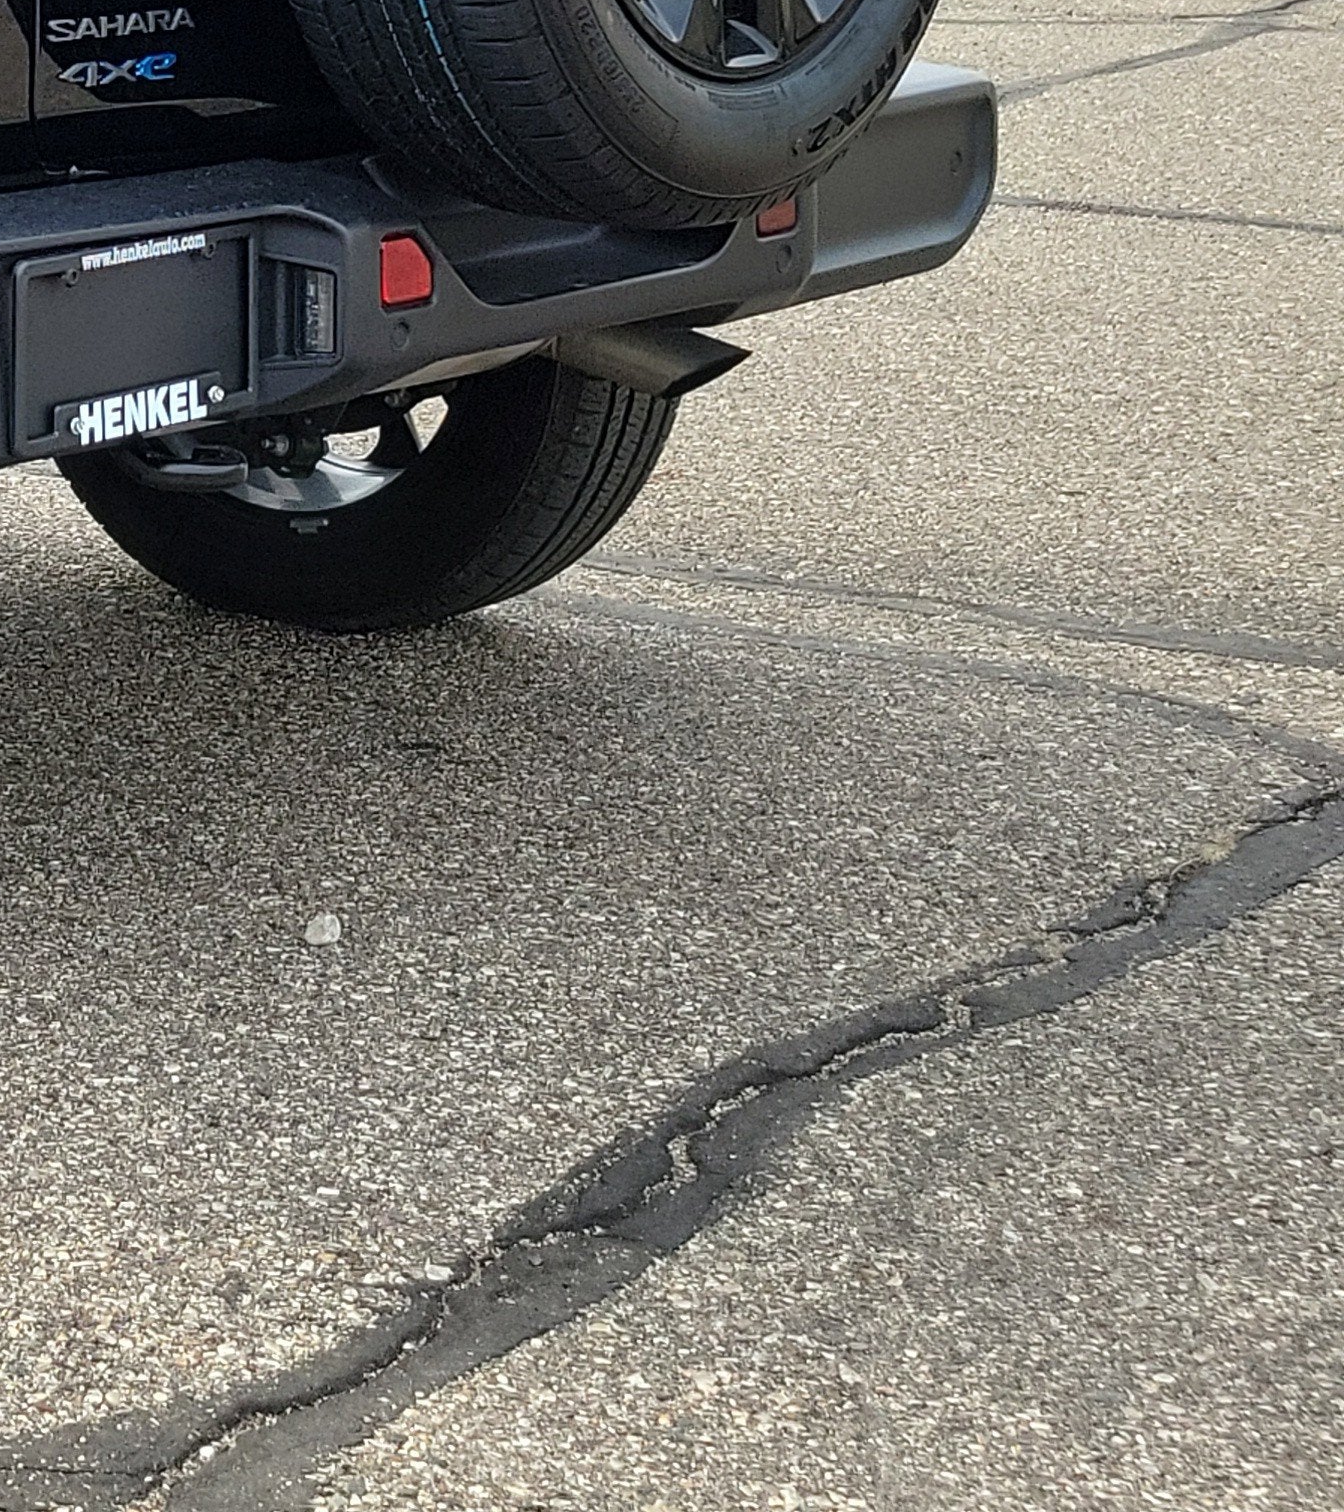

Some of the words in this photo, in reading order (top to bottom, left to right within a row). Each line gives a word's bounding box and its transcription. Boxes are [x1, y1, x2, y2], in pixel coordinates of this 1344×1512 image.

[46, 7, 196, 43] SAHARA
[81, 233, 207, 271] www.henkelauto.com
[78, 378, 208, 446] HENKEL
